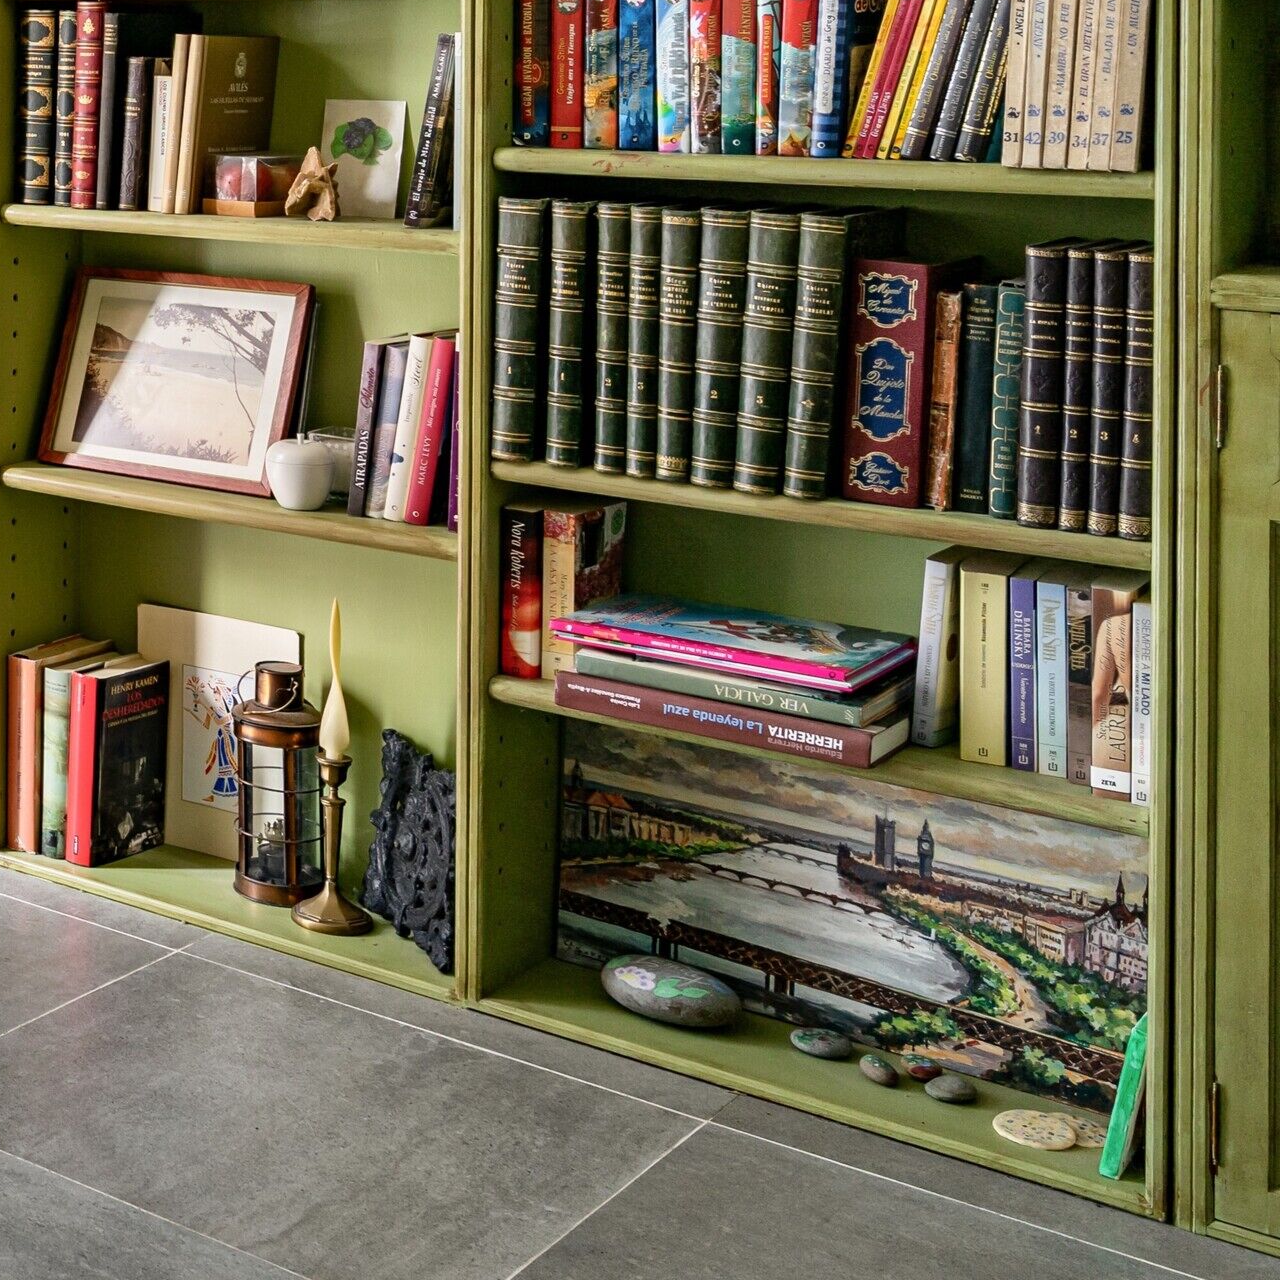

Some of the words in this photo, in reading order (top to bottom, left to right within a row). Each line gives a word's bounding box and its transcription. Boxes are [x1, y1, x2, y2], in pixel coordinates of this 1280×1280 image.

[523, 1, 532, 35] RATONIA
[1015, 8, 1025, 38] ANGEL
[1060, 4, 1071, 24] FUE
[1082, 0, 1096, 53] DETECTIVE
[567, 23, 576, 55] Tiempo
[1127, 33, 1138, 47] UN
[824, 46, 832, 75] DIARIO
[1080, 54, 1091, 83] GRAN
[432, 82, 441, 99] ANA
[523, 86, 532, 107] GRAN
[566, 83, 575, 105] Viaje
[1079, 84, 1089, 98] EL
[424, 106, 437, 138] Redfield
[1004, 131, 1020, 143] 31
[1024, 131, 1041, 145] 42
[1047, 131, 1065, 144] 39
[1092, 131, 1109, 146] 37
[1115, 131, 1133, 144] 25
[420, 139, 431, 158] Miss
[415, 168, 426, 192] coraje
[412, 193, 420, 202] El
[861, 370, 905, 392] Quijote
[860, 405, 904, 419] Mancha
[1070, 428, 1078, 439] 2
[1100, 430, 1108, 441] 3
[421, 435, 432, 458] LEVY
[354, 429, 370, 490] ATRAPADAS
[417, 459, 429, 486] MARC
[511, 519, 526, 547] Nora
[510, 548, 525, 590] Roberts
[1013, 610, 1024, 660] DELINSKY
[1023, 617, 1032, 654] BARBARA
[1141, 618, 1151, 661] SIEMPRE
[110, 681, 135, 696] HENRY
[134, 674, 159, 689] KAMEN
[1141, 672, 1151, 686] MI
[714, 683, 775, 707] GALICIA
[779, 696, 810, 714] VER
[1140, 687, 1151, 716] LADO
[663, 703, 691, 719] azul
[692, 708, 744, 730] leyenda
[746, 720, 764, 734] La
[768, 725, 844, 751] HERRERITA
[804, 744, 844, 760] Eduardo
[1100, 778, 1117, 788] ZETA
